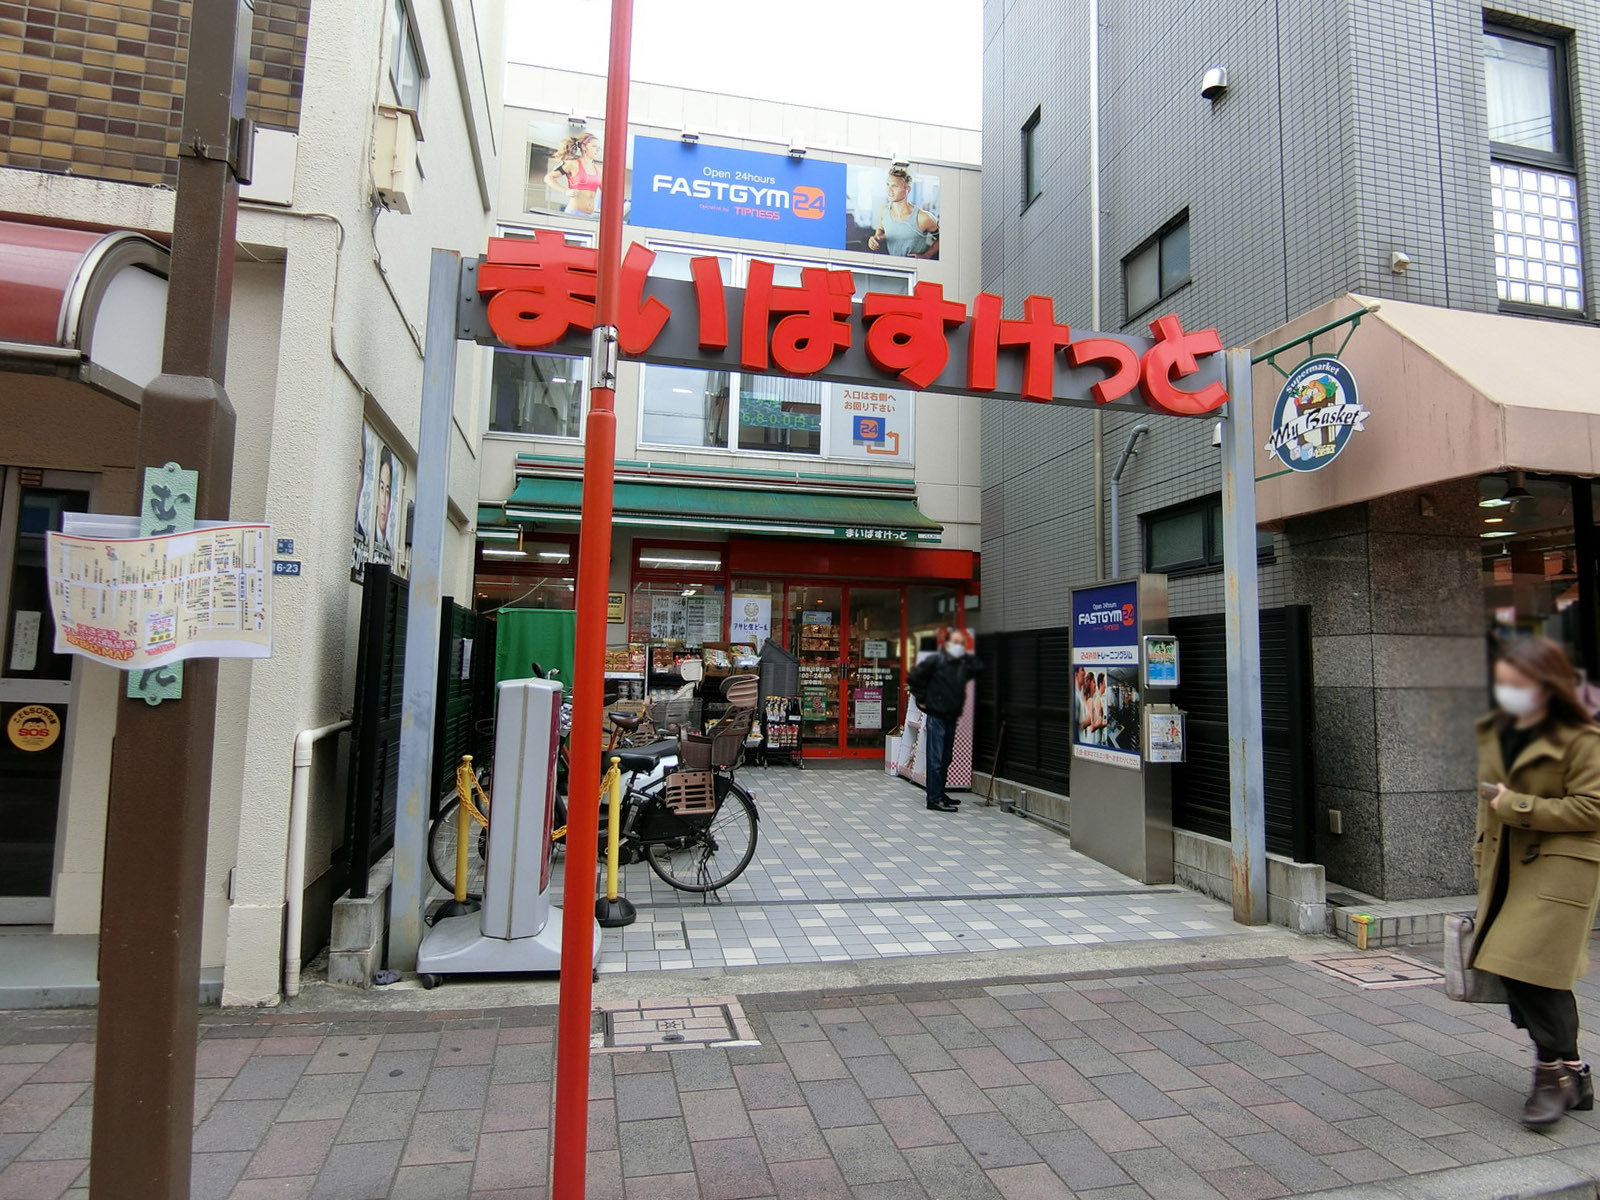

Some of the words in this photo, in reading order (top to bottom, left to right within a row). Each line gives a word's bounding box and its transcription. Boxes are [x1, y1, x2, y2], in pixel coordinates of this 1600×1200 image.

[703, 166, 731, 180] Open
[735, 171, 776, 185] 24hours
[652, 174, 790, 208] FASTGYM
[792, 188, 826, 218] 24
[734, 206, 780, 220] TIPNESS
[478, 228, 1229, 416] まいばすけっと
[1286, 361, 1340, 394] supermarket
[843, 389, 897, 402] 入口は右側へ
[844, 401, 896, 413] お回り下さい
[859, 422, 879, 436] 24
[1269, 422, 1299, 449] My
[1306, 404, 1360, 429] Basket
[845, 528, 908, 540] まいばすけっと
[1078, 609, 1122, 625] FASTGYM
[734, 623, 769, 631] アサヒ生ビール
[18, 728, 50, 737] SOS
